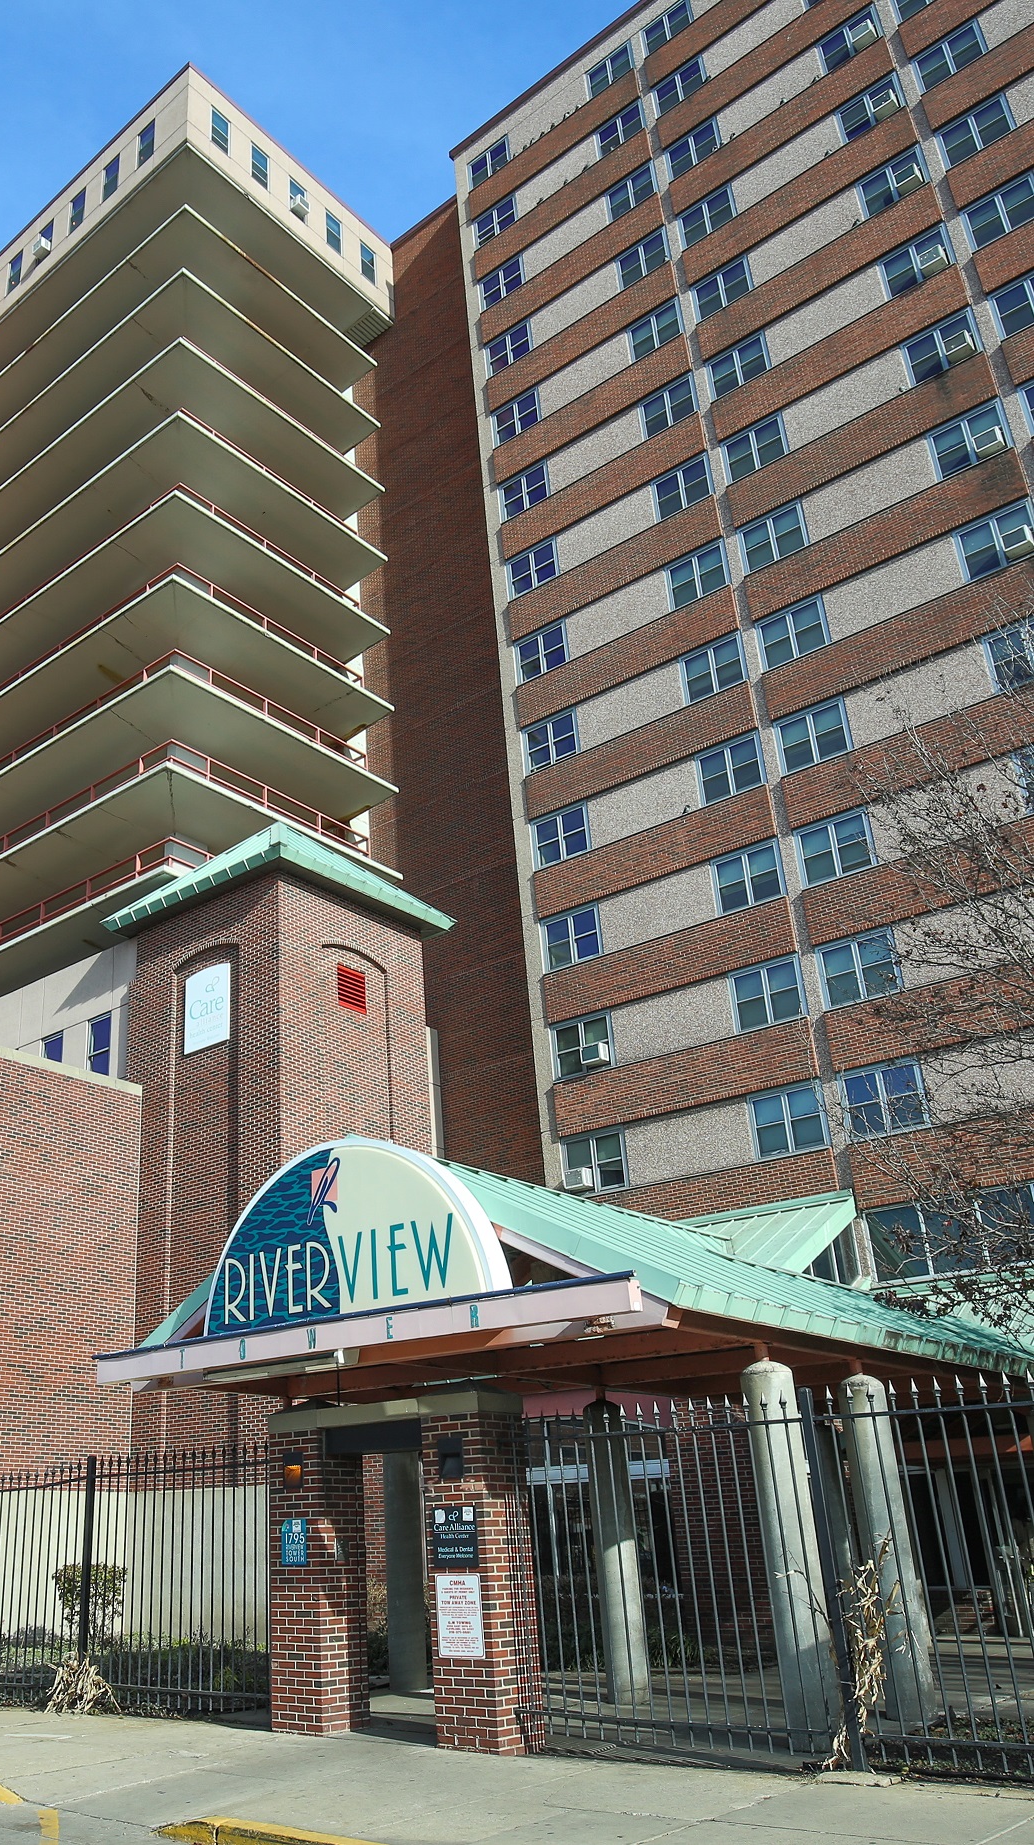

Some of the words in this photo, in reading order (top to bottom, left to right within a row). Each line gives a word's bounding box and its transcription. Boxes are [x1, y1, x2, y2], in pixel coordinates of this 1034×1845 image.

[189, 996, 224, 1020] Care
[197, 1013, 224, 1027] alliance
[189, 1028, 206, 1039] health
[206, 1022, 223, 1033] center
[286, 1533, 304, 1544] 1795
